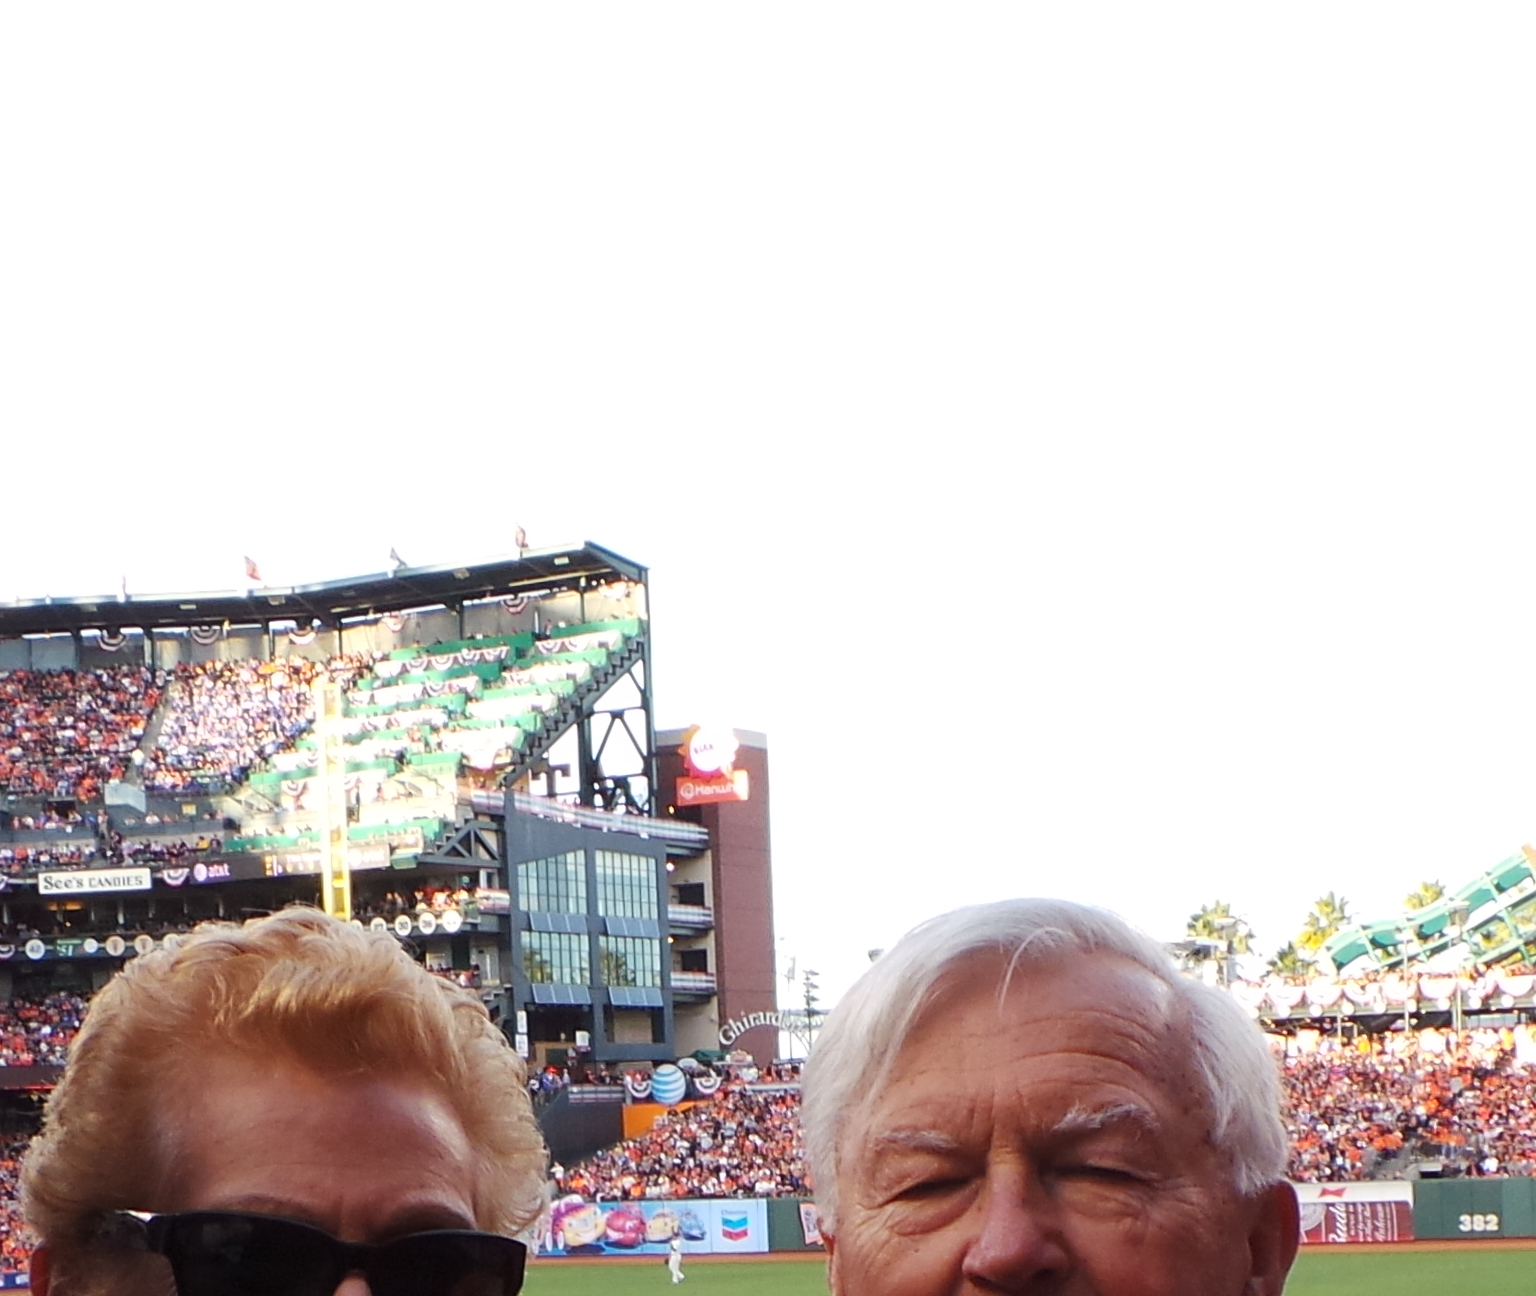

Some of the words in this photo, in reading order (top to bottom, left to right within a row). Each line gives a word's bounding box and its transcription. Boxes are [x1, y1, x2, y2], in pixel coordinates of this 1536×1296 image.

[43, 872, 85, 891] See's
[88, 874, 144, 889] CANDIES
[1458, 1213, 1500, 1232] 382
